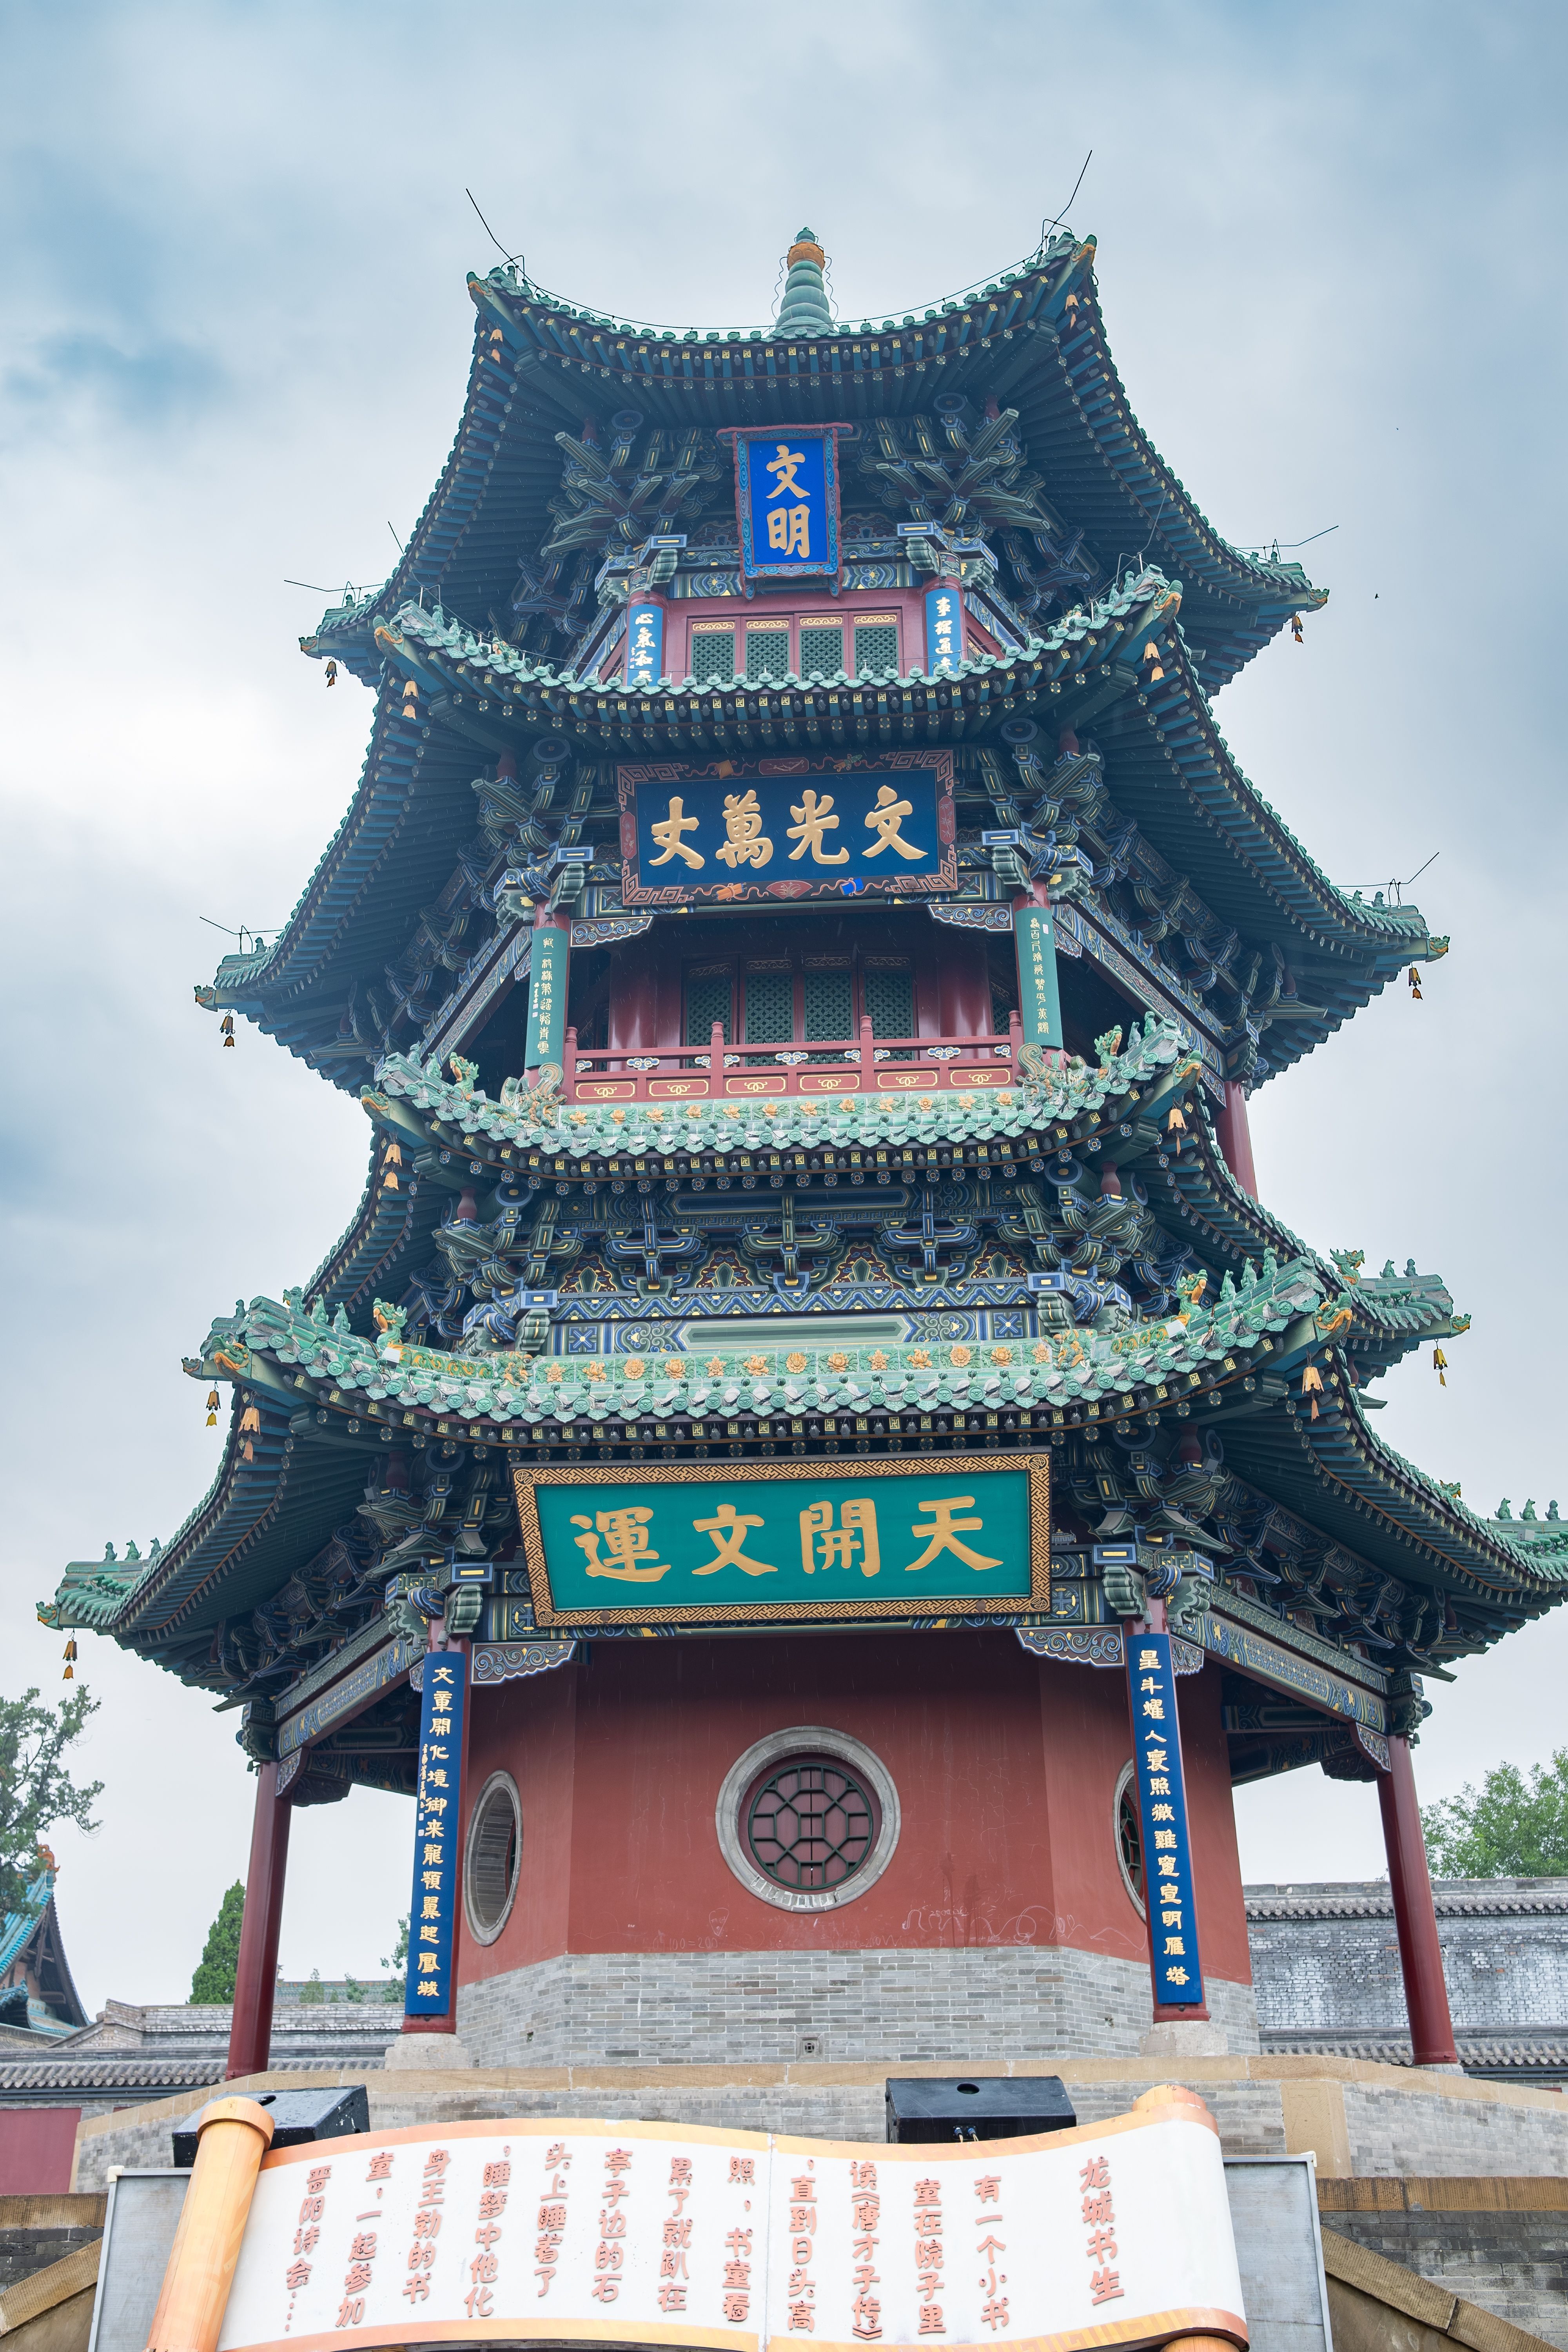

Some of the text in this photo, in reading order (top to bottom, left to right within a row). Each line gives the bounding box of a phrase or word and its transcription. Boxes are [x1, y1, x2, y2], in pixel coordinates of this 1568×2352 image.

[766, 445, 810, 558] 文明
[570, 1496, 1004, 1582] 天開文運
[403, 2149, 450, 2304] 身王勃的书
[534, 2143, 572, 2297] 头上睡着了
[592, 2148, 633, 2302] 亭子边的石
[657, 2157, 692, 2312] 累了就趴在
[913, 2178, 946, 2334] 童在院子里
[975, 2175, 1010, 2330] 有一个小书
[1079, 2156, 1124, 2306] 龙城书生
